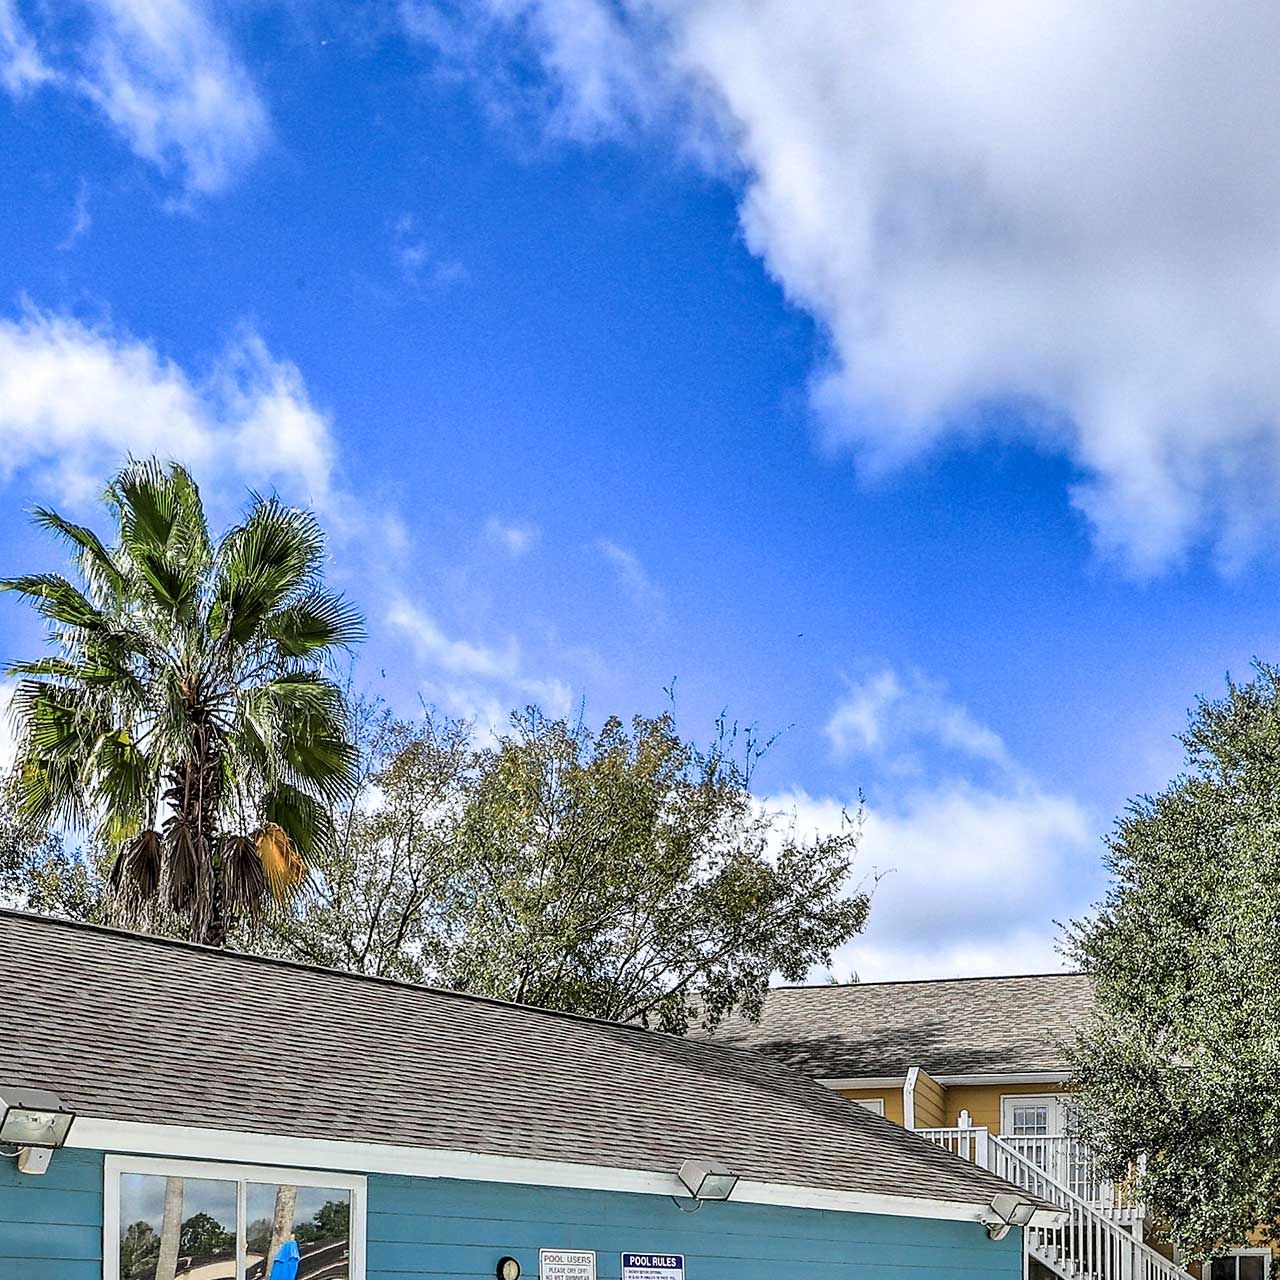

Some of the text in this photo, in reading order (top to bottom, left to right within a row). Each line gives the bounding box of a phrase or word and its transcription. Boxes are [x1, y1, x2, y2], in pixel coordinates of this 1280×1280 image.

[544, 1255, 591, 1264] POOL USERS
[630, 1256, 677, 1267] POOL RULES
